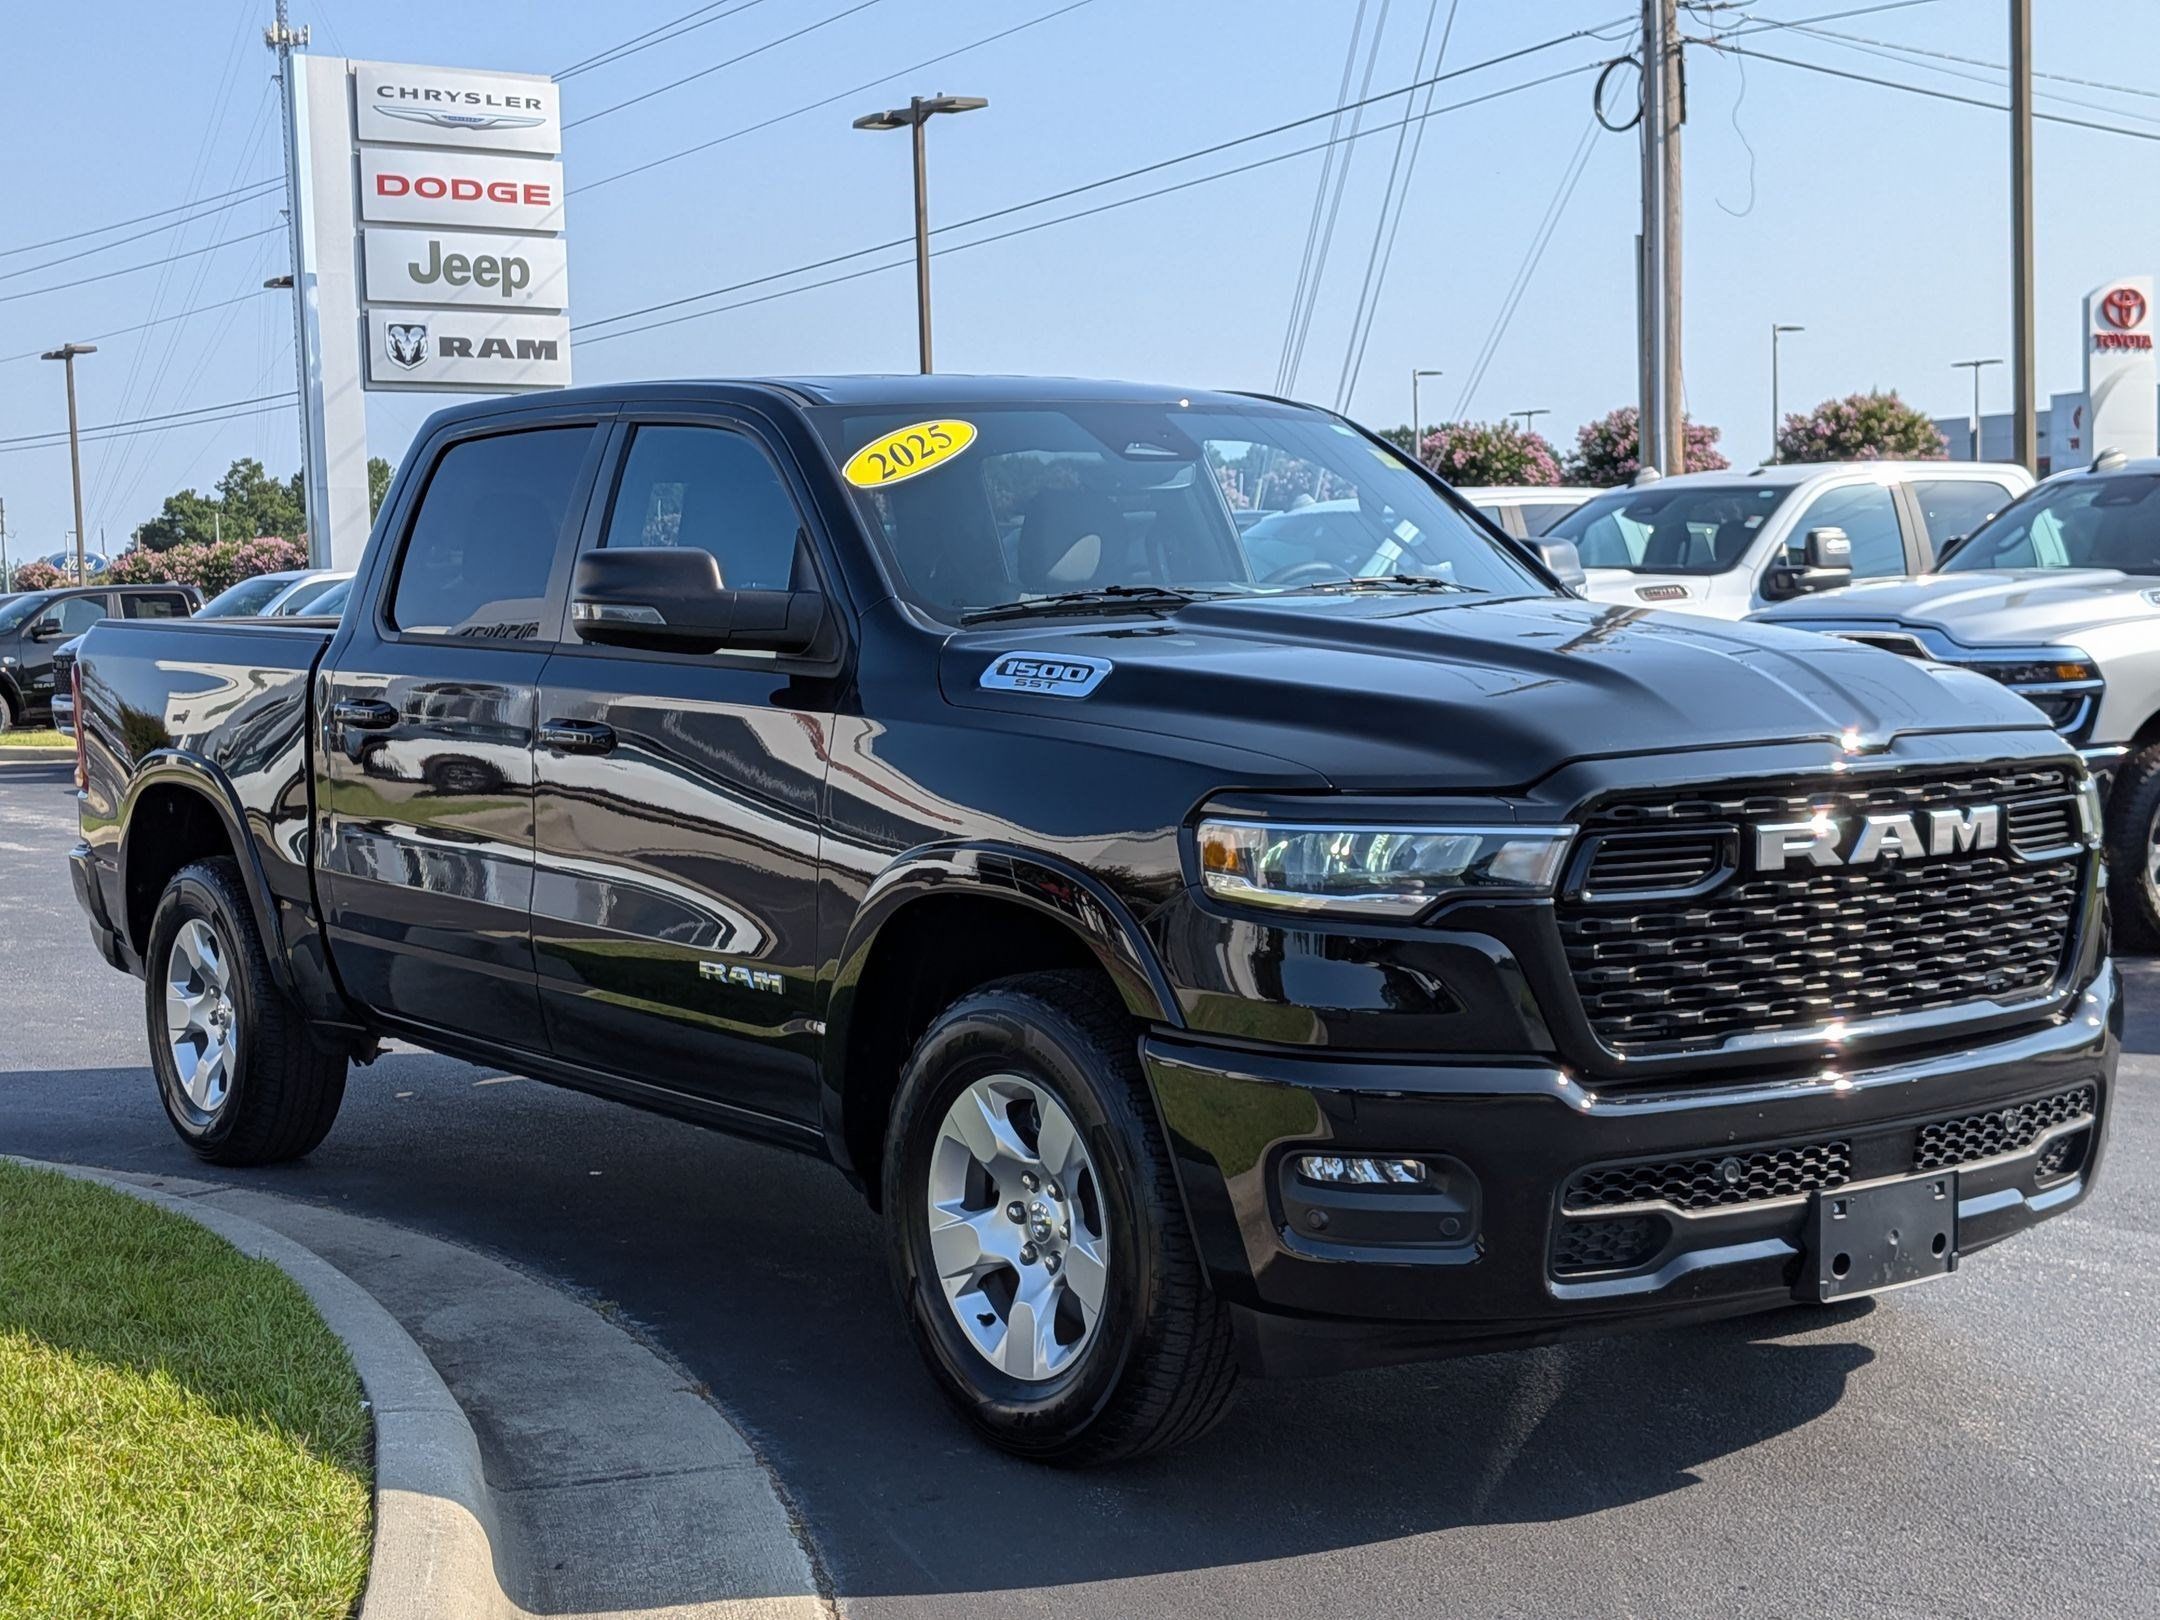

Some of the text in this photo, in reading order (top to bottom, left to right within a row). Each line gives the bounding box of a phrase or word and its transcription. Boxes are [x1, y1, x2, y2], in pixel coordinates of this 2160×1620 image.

[376, 86, 542, 110] CHRYSLER
[376, 174, 552, 206] DODGE
[408, 240, 531, 298] Jeep
[439, 336, 558, 361] RAM
[2094, 334, 2153, 349] TOYOTA
[868, 424, 952, 480] 2025
[1004, 660, 1090, 682] 1500
[1014, 678, 1060, 690] SST
[1755, 804, 1999, 872] RAM
[699, 960, 784, 995] RAM
